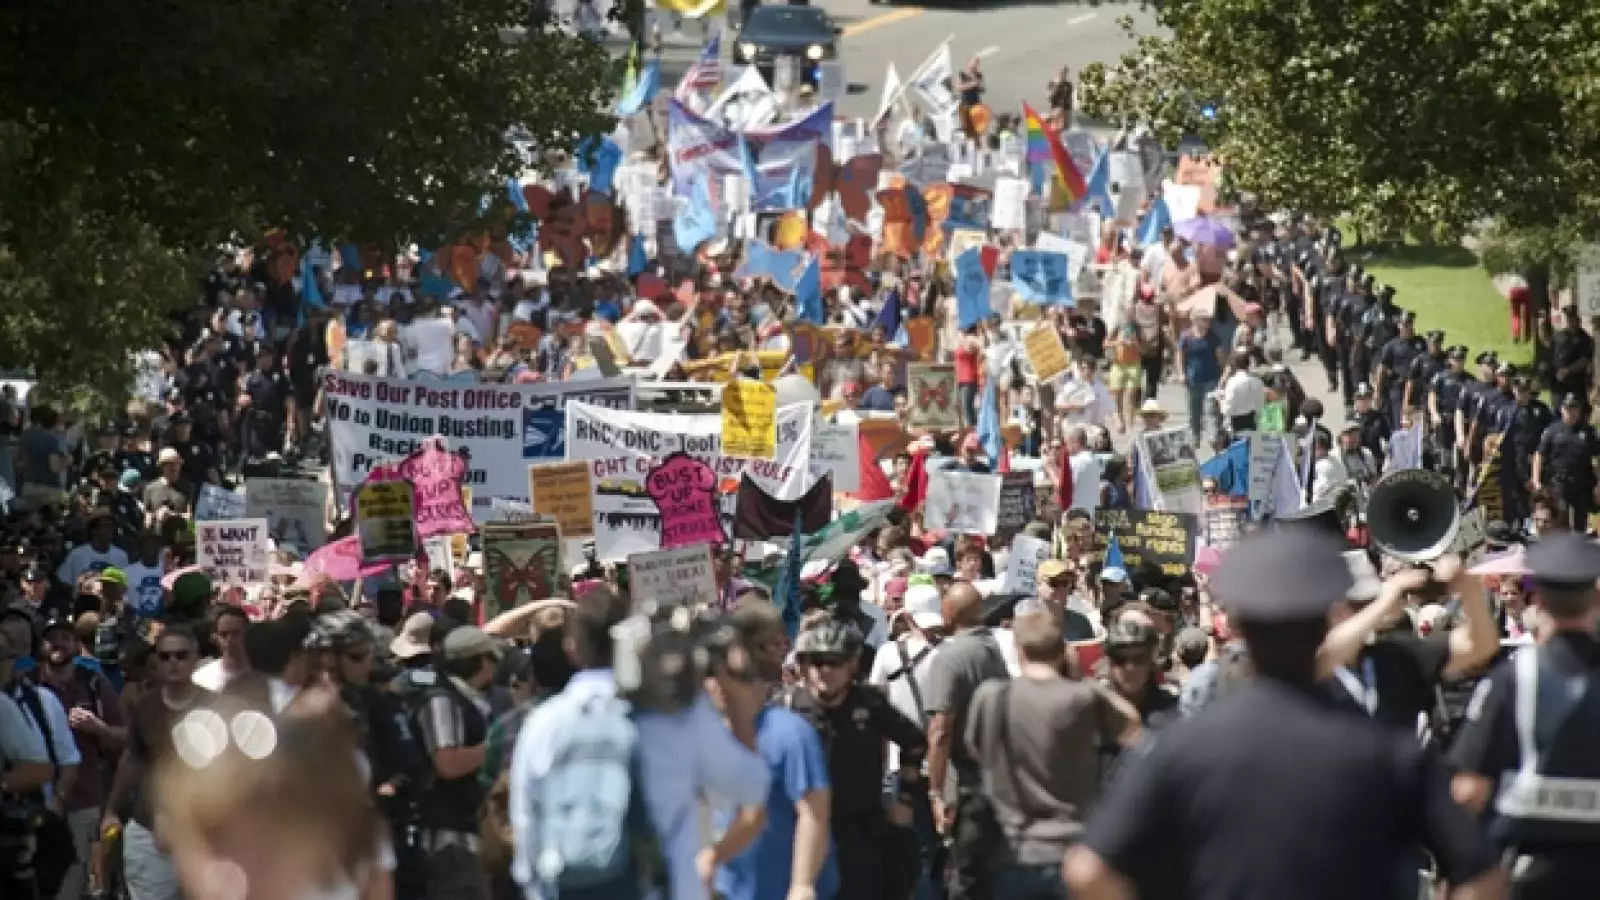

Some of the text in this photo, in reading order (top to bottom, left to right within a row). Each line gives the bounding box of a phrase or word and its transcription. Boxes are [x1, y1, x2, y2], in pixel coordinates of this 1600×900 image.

[325, 374, 370, 400] Save
[376, 381, 411, 405] Our
[415, 385, 459, 409] Post
[464, 390, 521, 409] Office
[328, 398, 350, 421] No
[354, 409, 370, 425] to
[376, 408, 434, 434] Union
[654, 466, 704, 490] BUST
[672, 486, 693, 502] UP
